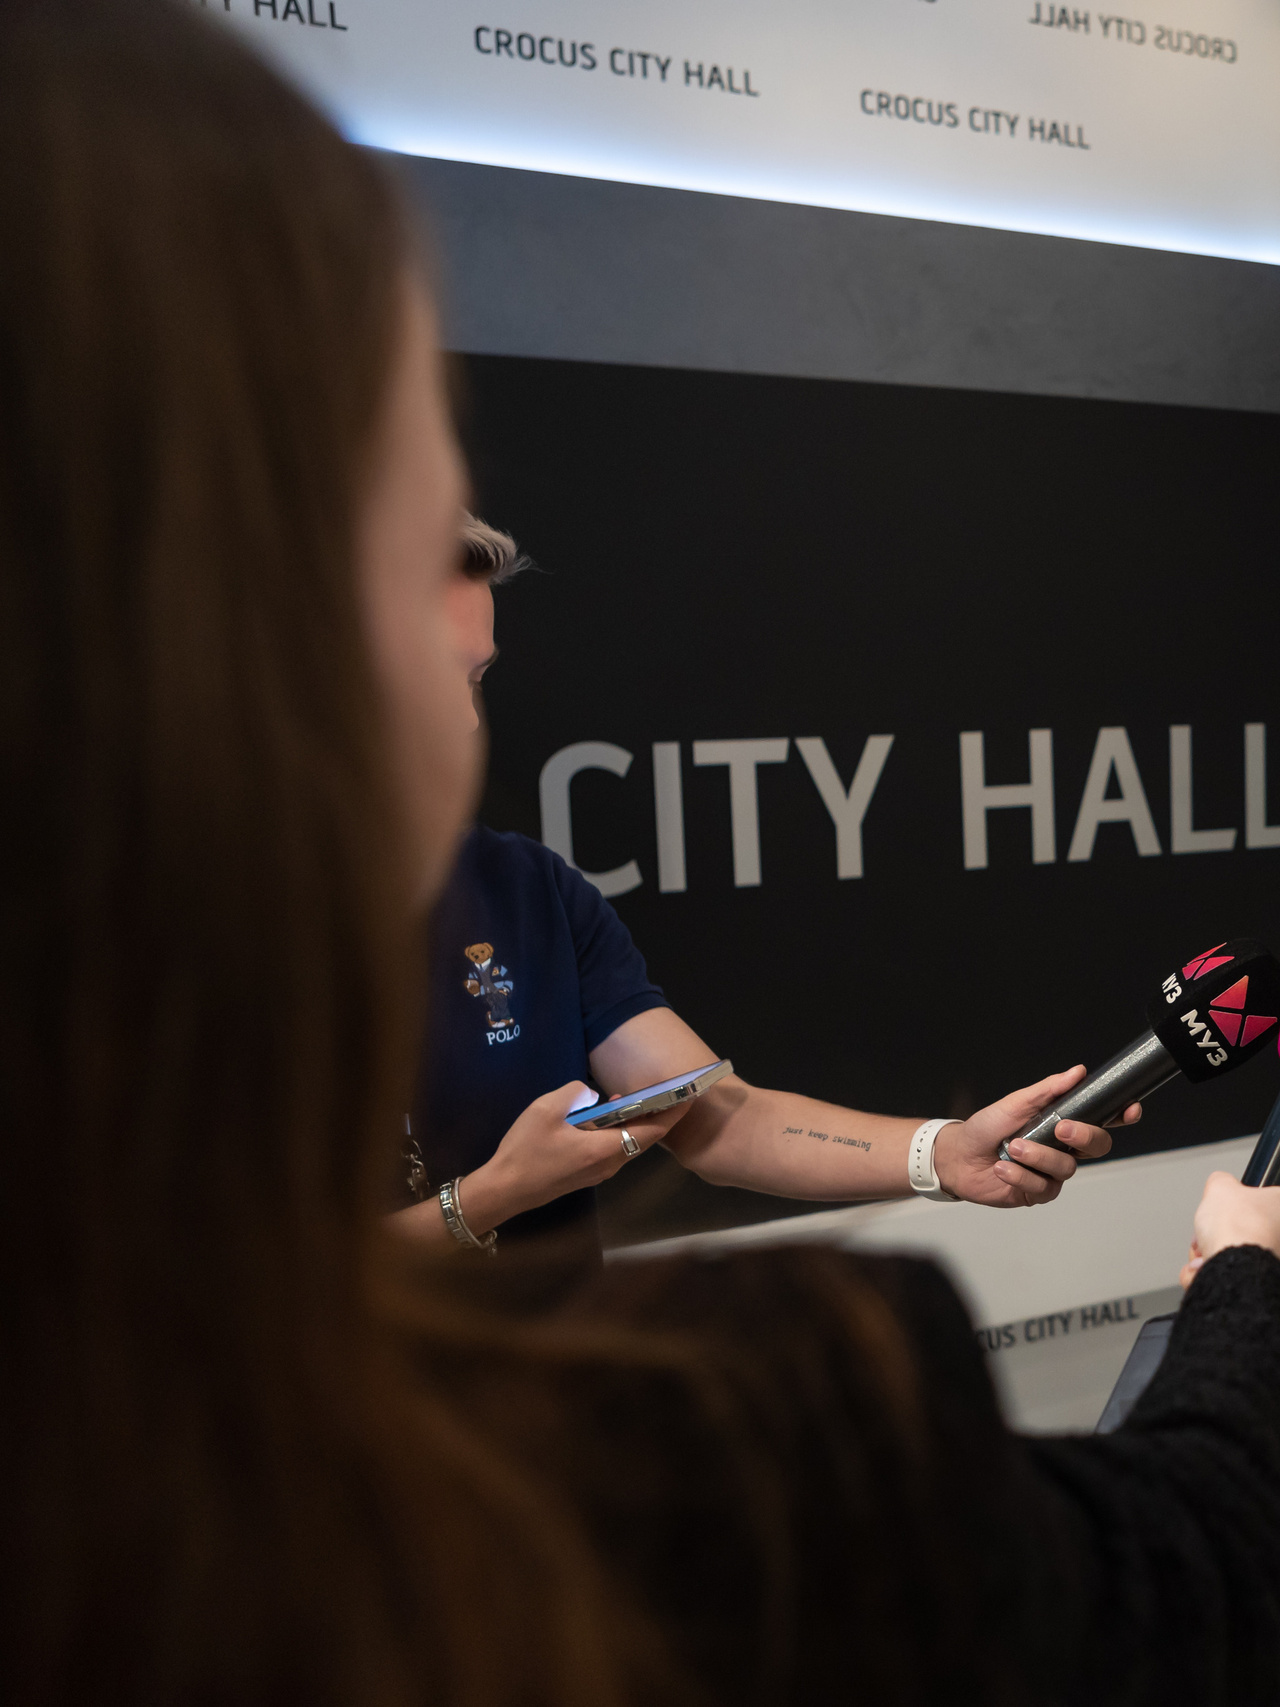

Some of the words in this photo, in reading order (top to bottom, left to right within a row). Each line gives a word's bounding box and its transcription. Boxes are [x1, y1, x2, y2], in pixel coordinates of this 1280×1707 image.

[254, 0, 348, 31] HALL
[474, 25, 597, 71] CROCUS
[609, 47, 671, 82] CITY
[683, 59, 760, 97] HALL
[860, 90, 959, 128] CROCUS
[968, 108, 1020, 137] CITY
[1028, 118, 1091, 150] HALL
[538, 734, 894, 899] CITY
[486, 1025, 520, 1045] POLO
[782, 1126, 803, 1135] just
[808, 1129, 828, 1142] keep
[832, 1136, 872, 1152] swimming
[1024, 1310, 1073, 1342] CITY
[1081, 1299, 1139, 1330] HALL
